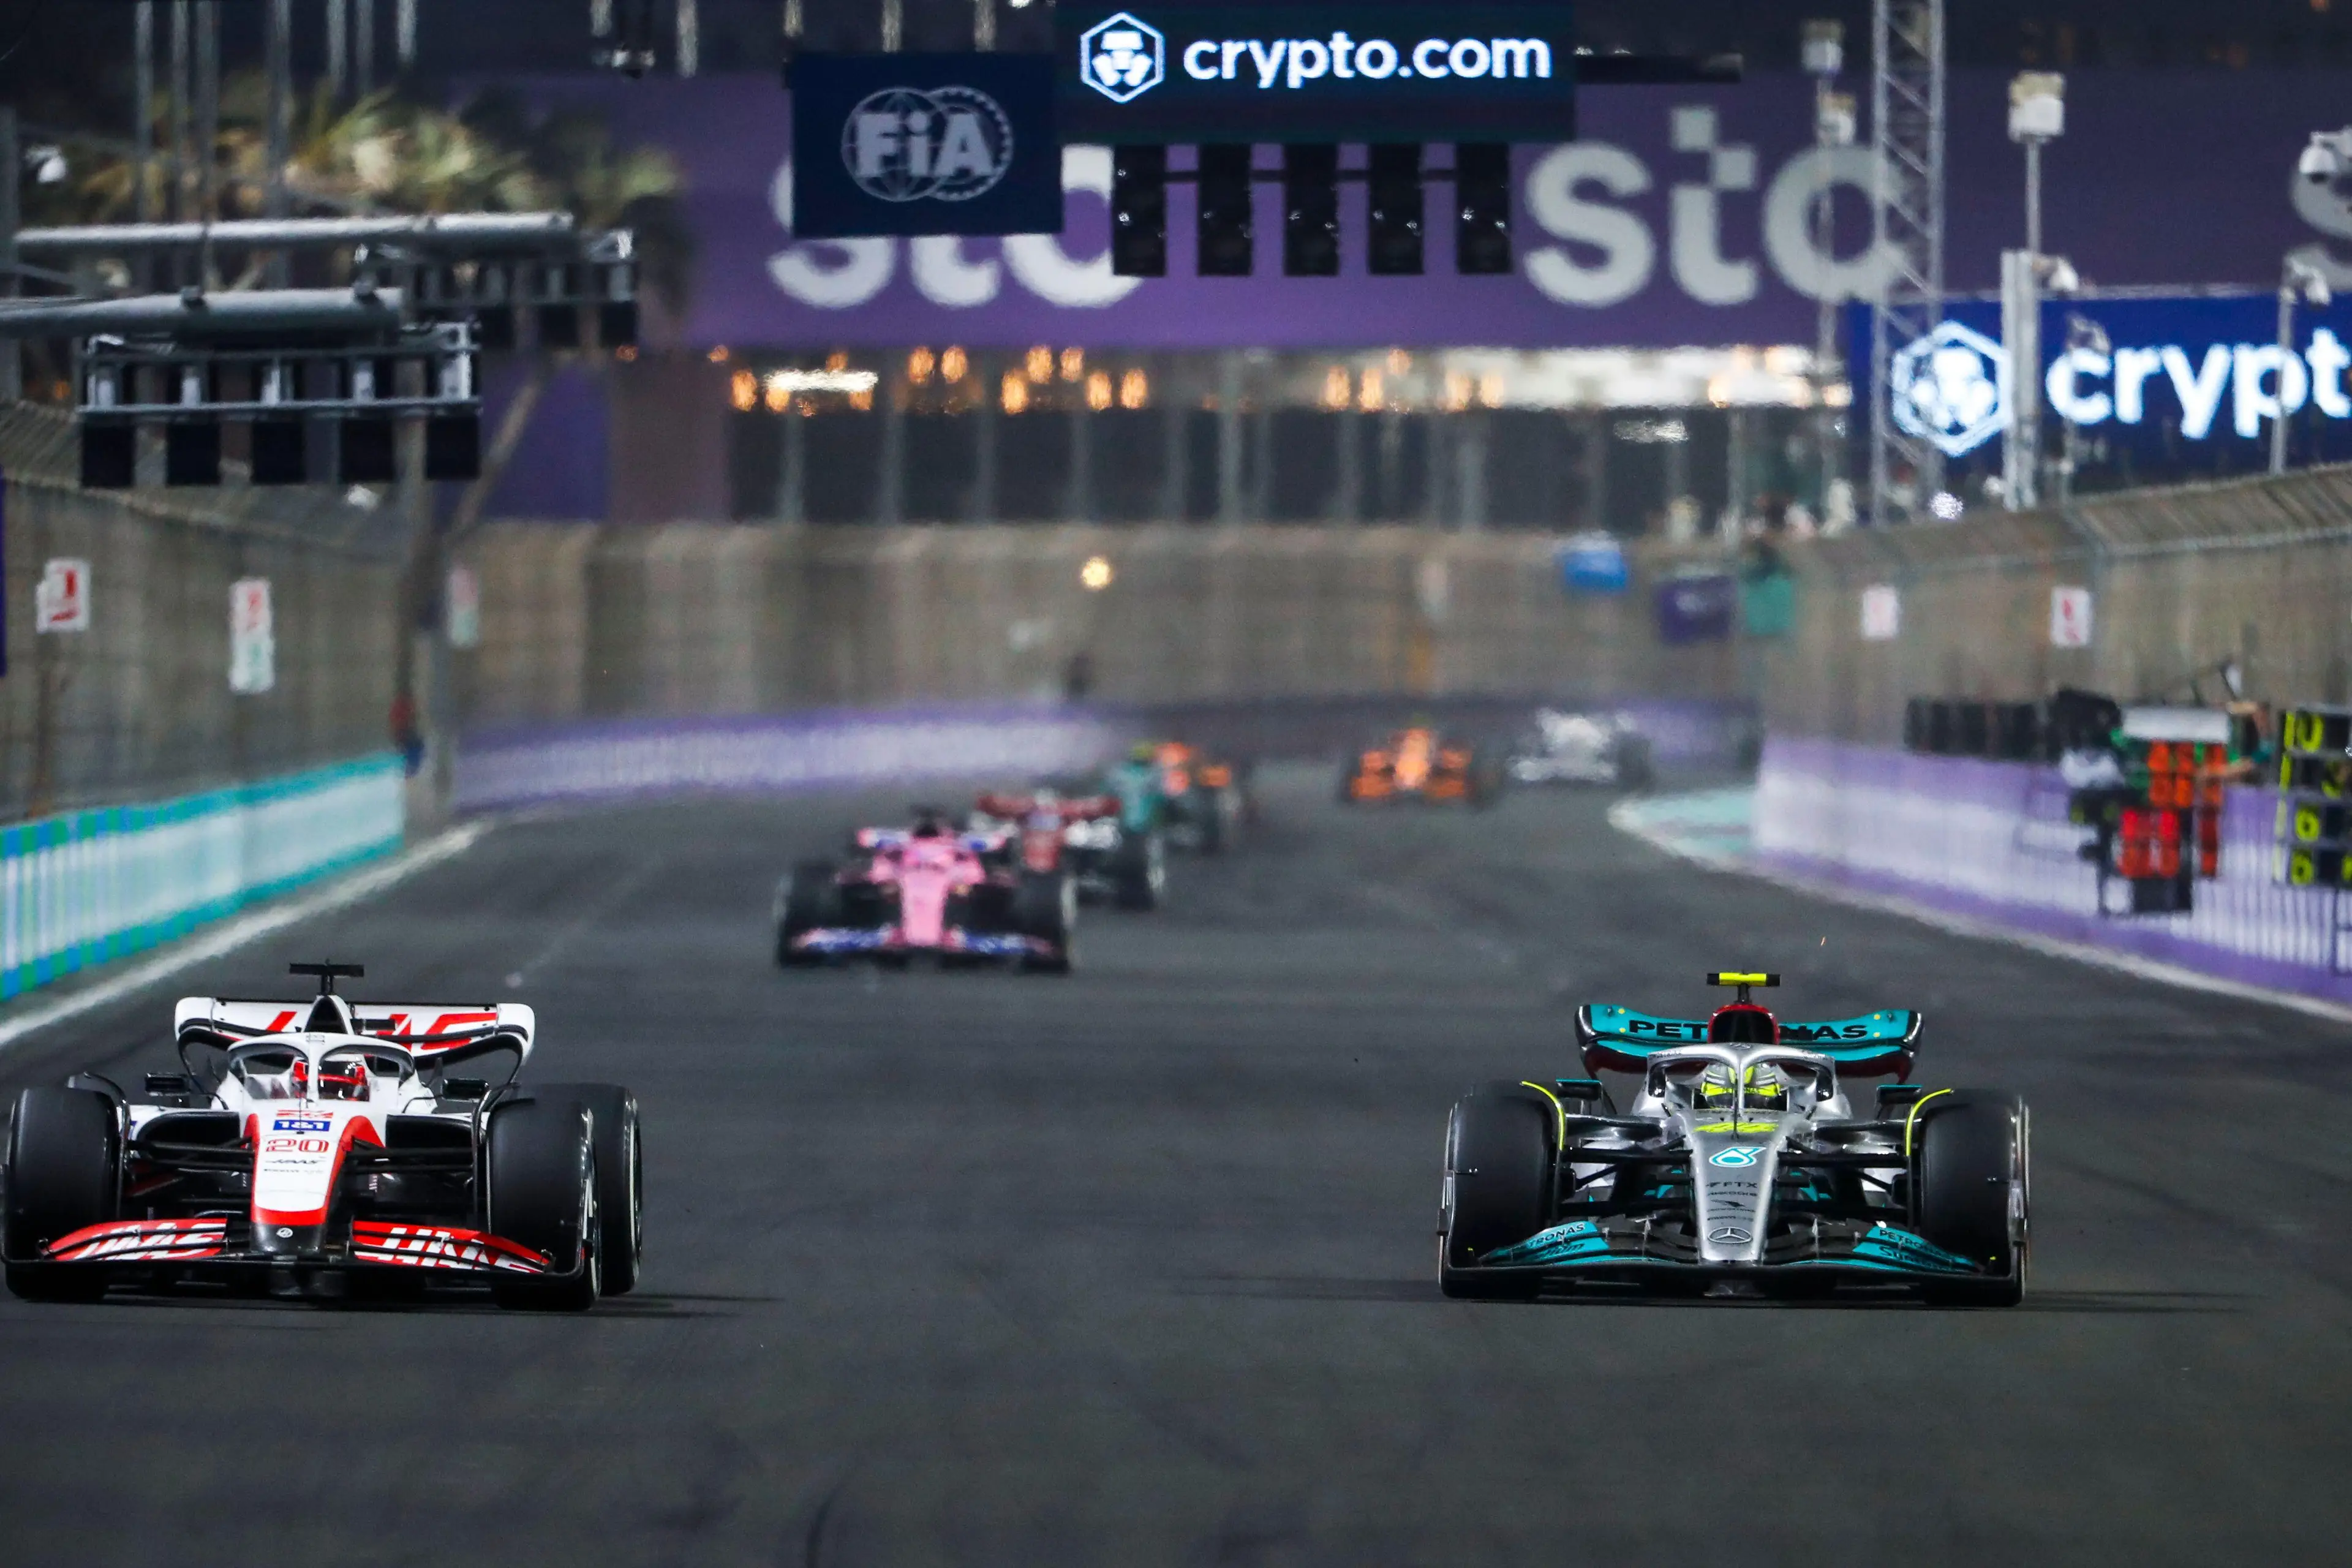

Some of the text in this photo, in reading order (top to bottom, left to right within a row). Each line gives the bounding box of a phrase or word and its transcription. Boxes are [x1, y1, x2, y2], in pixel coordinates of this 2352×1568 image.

[1183, 31, 1551, 89] crypto.com
[1629, 1019, 1868, 1040] PETAS
[278, 1120, 325, 1130] 1&1
[265, 1138, 330, 1153] 20
